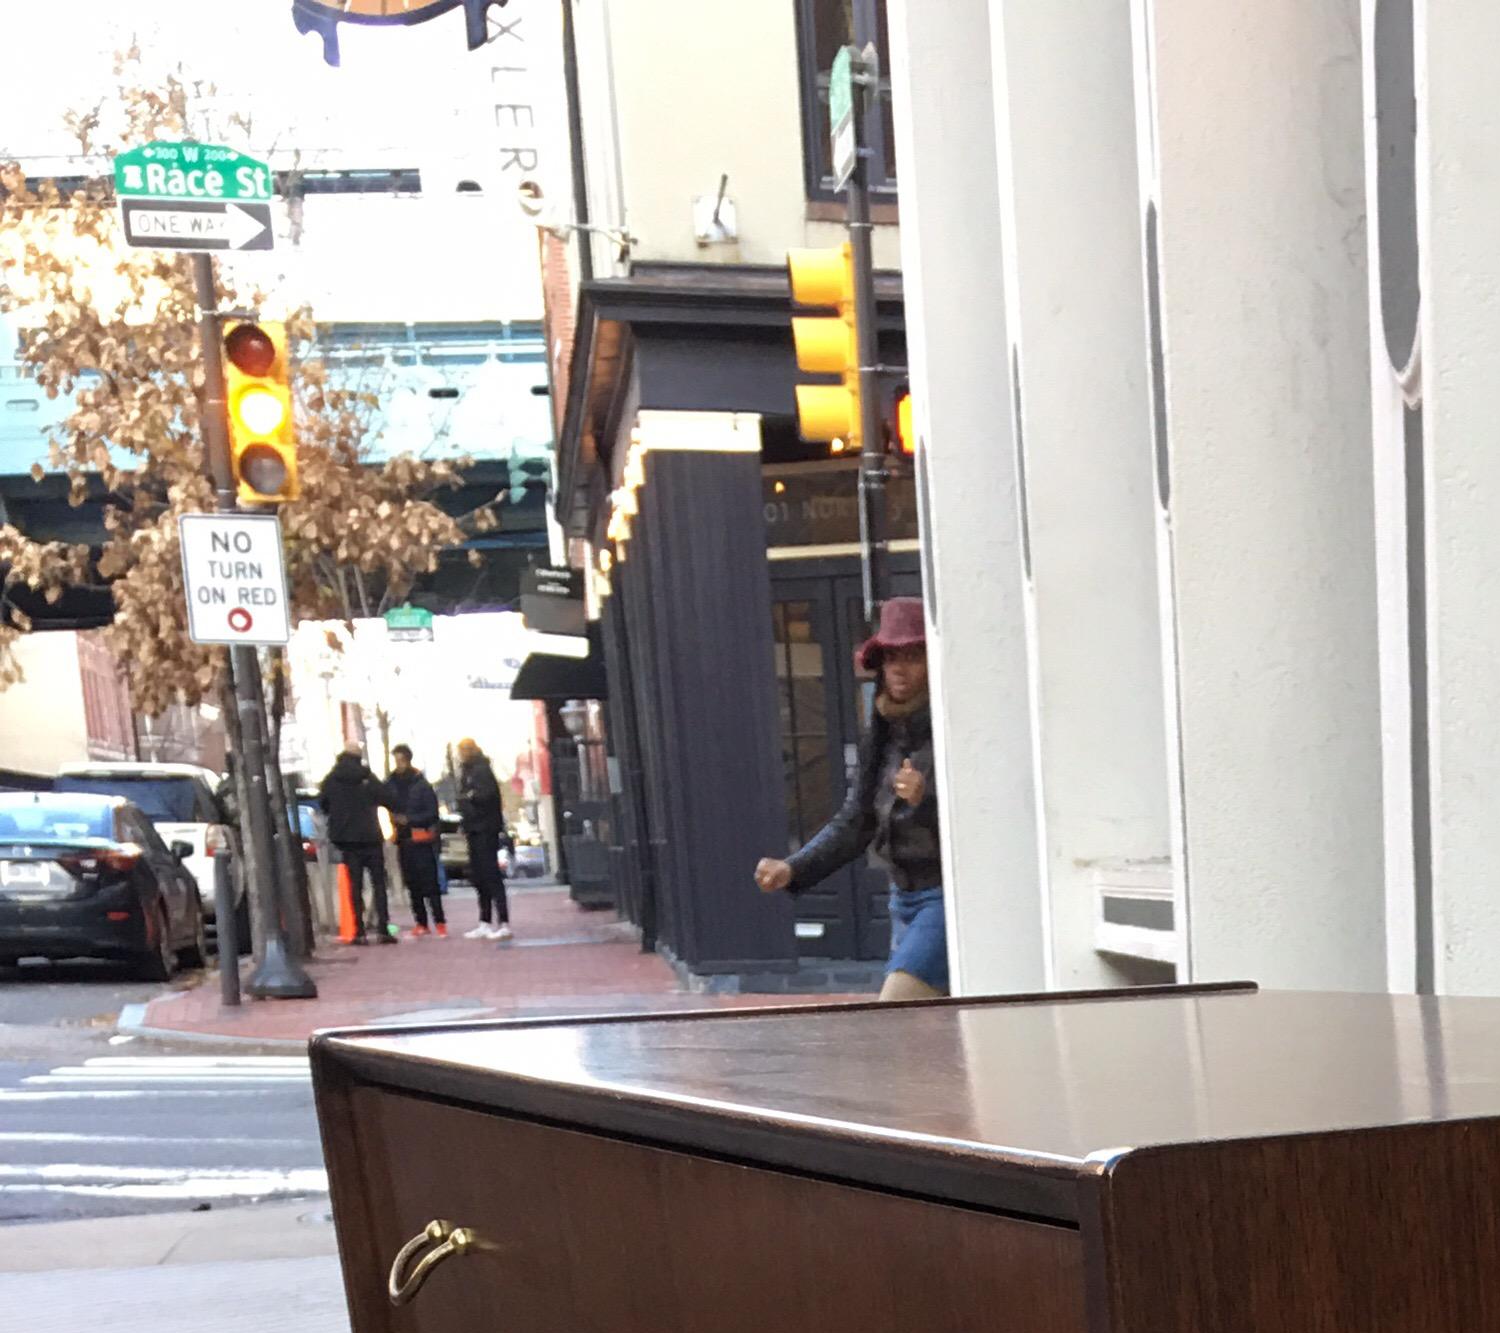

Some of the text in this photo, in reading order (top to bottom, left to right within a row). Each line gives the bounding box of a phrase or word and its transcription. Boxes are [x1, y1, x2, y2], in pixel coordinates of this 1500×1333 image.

[182, 147, 199, 163] W
[146, 163, 269, 198] Race St
[138, 213, 225, 234] ONE WA
[211, 530, 252, 554] NO
[208, 560, 263, 580] TURN
[197, 585, 277, 606] ON RED
